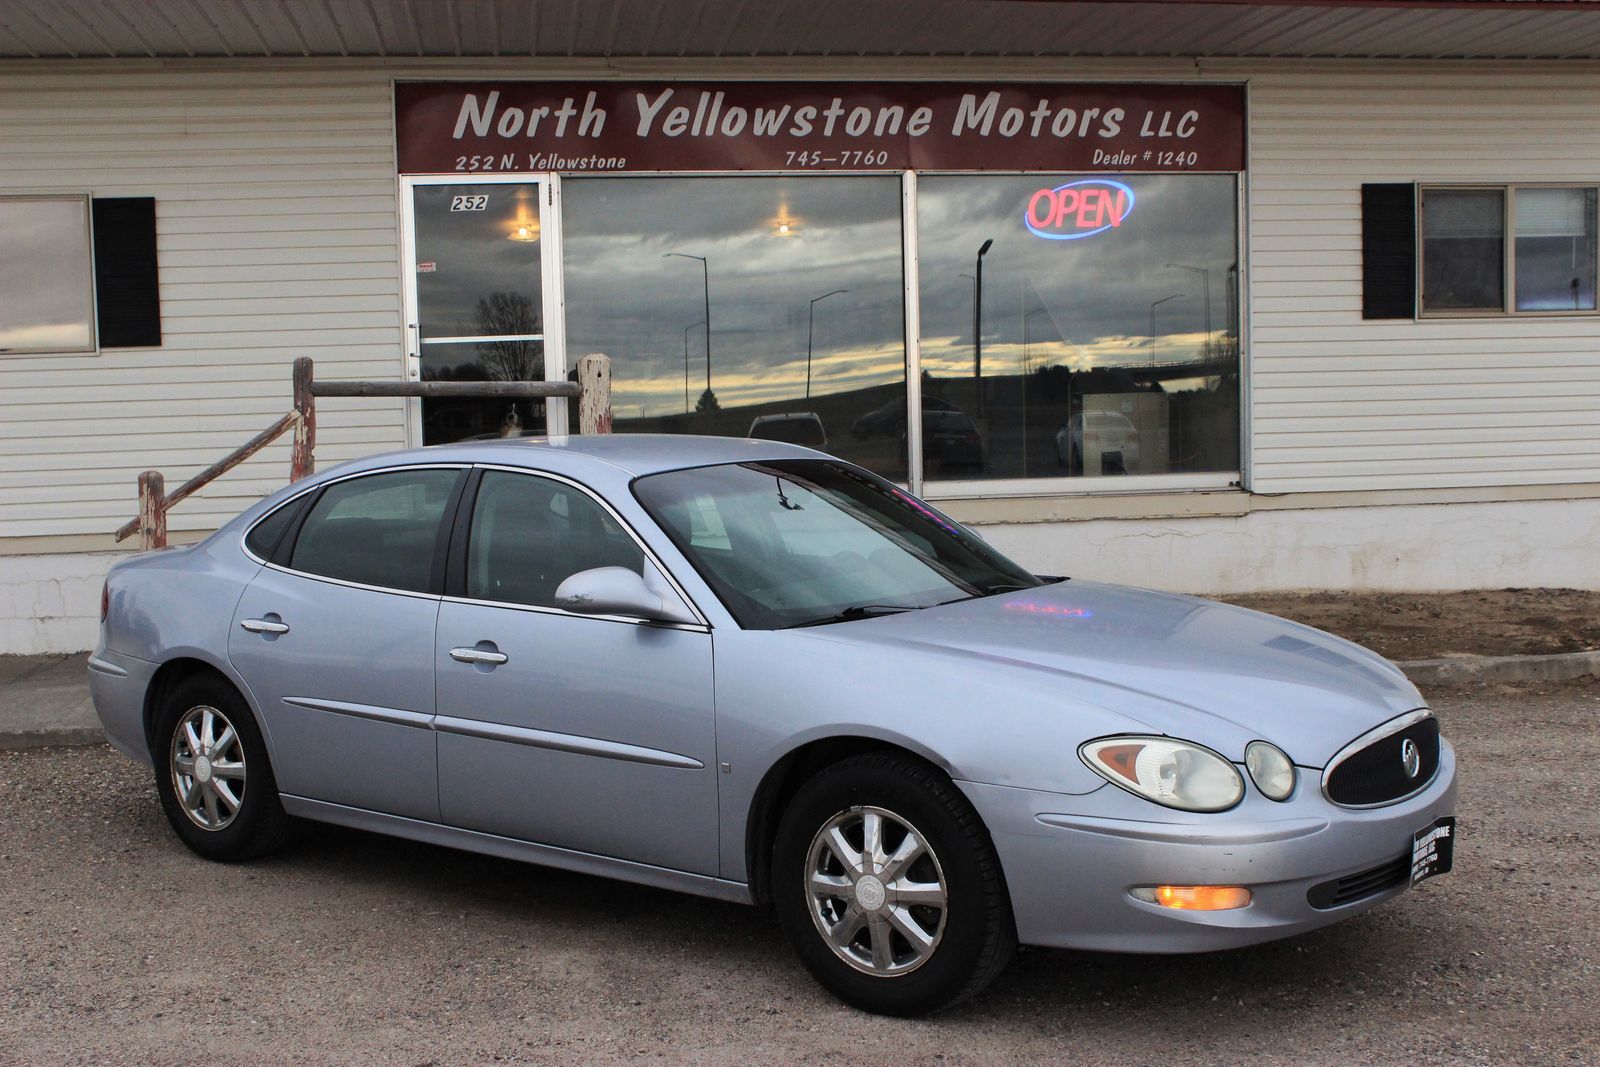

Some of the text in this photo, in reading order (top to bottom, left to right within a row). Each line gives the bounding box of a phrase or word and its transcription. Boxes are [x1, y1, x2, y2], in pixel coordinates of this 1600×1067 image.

[453, 88, 1199, 139] North Yellowstone Motors LLC
[455, 152, 626, 171] 252 N. Yellowstone
[786, 149, 888, 166] 745-7760
[1092, 149, 1137, 165] Dealer
[1157, 151, 1198, 166] 1240
[452, 196, 487, 211] 252
[1028, 189, 1124, 227] OPEN
